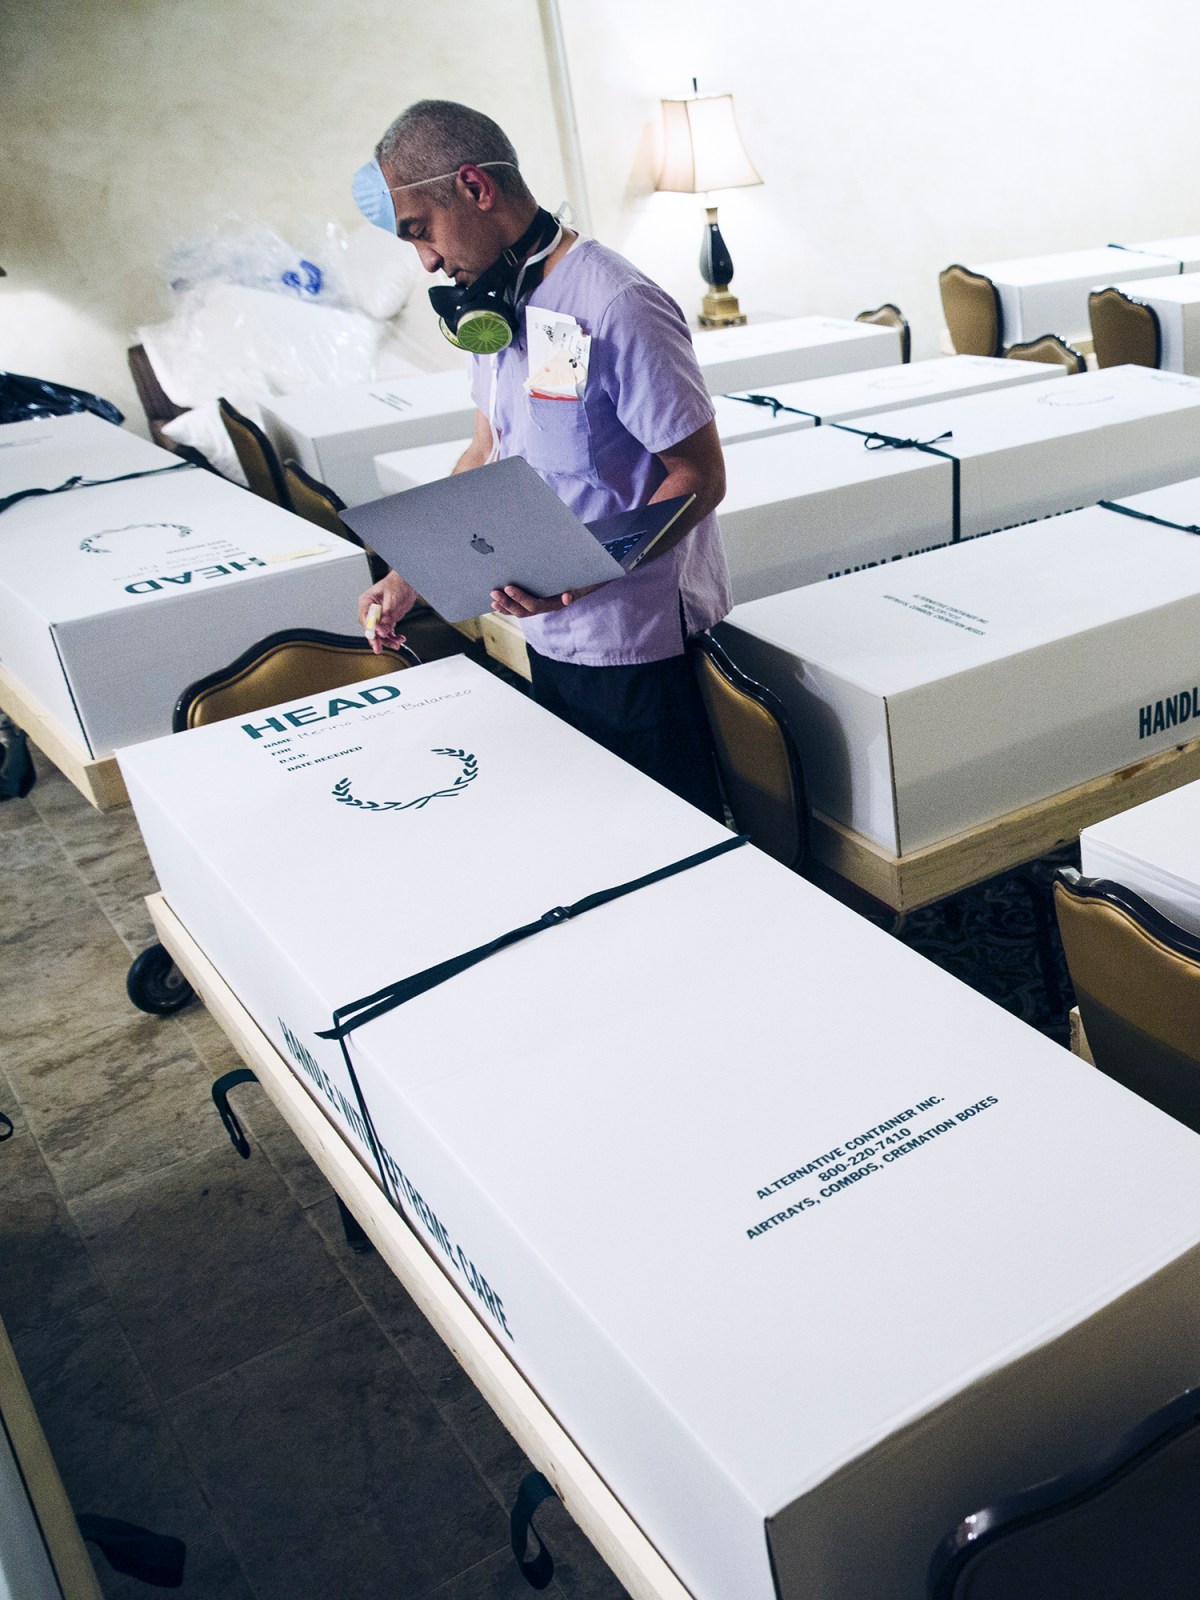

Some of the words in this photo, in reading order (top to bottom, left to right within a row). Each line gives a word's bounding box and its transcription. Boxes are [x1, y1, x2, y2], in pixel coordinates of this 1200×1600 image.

[125, 557, 267, 594] HEAD
[241, 685, 401, 740] HEAD
[263, 737, 293, 749] NAME
[271, 747, 292, 757] FOR
[279, 752, 309, 764] D.O.D.
[287, 761, 315, 772] DATE
[316, 745, 363, 764] RECEIVED
[746, 1197, 821, 1240] AIRTRAYS,
[819, 1162, 885, 1198] COMBOS,
[882, 1118, 957, 1164] CREMATION
[955, 1095, 999, 1122] BOXES
[756, 1147, 846, 1200] ALTERNATIVE
[845, 1108, 919, 1151] CONTAINER
[916, 1095, 945, 1112] INC.
[818, 1127, 912, 1182] 800-220-7410
[278, 1016, 341, 1113] HANDLE
[456, 1244, 515, 1342] CARE
